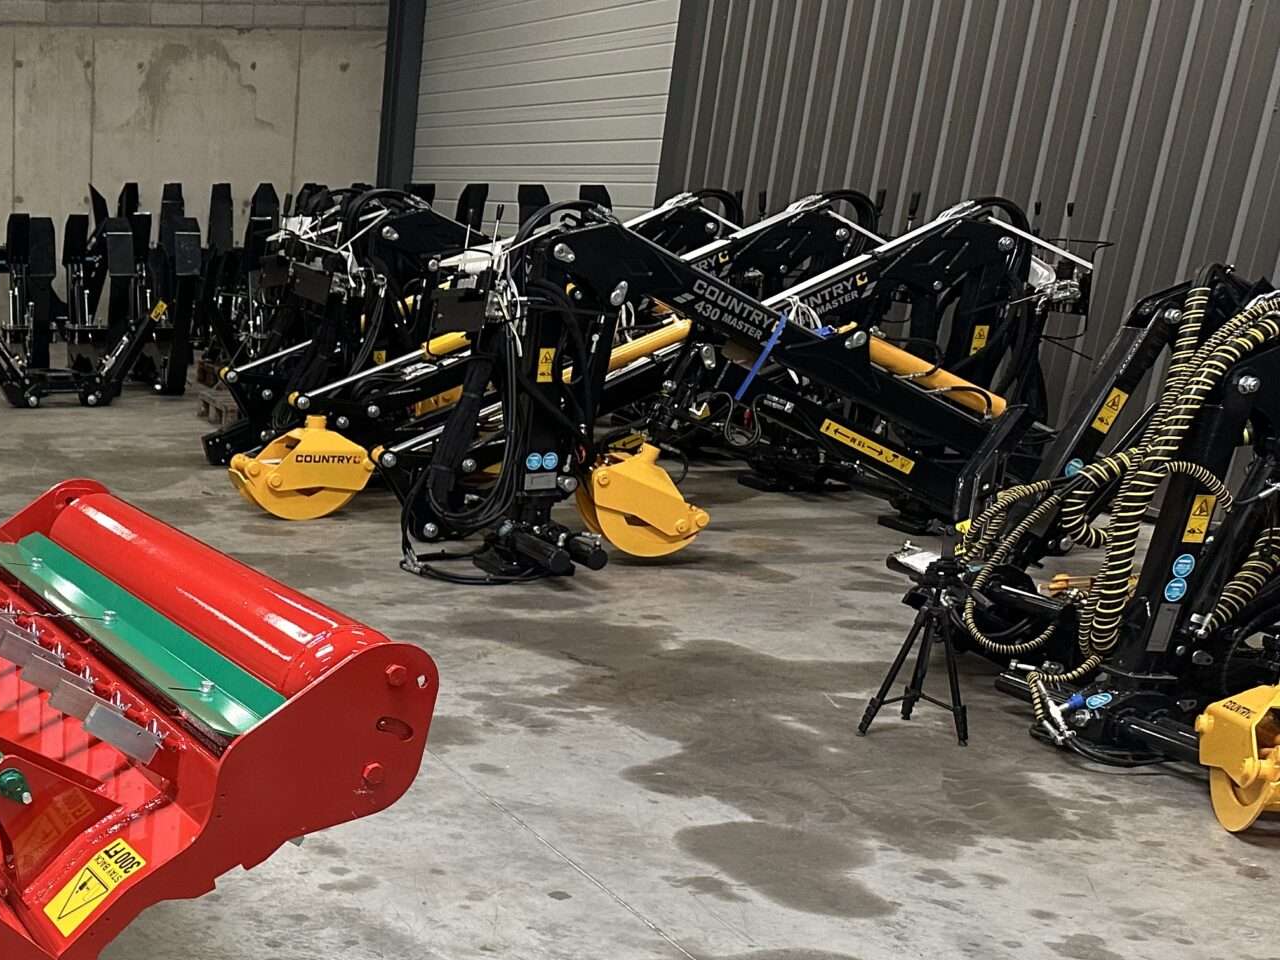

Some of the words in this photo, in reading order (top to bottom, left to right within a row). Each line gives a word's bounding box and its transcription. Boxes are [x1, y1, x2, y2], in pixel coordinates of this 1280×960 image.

[693, 279, 774, 328] COUNTRY
[816, 291, 859, 315] MASTER
[694, 301, 720, 320] 430
[721, 313, 763, 340] MASTER
[103, 842, 126, 859] FT
[95, 854, 111, 871] BACK
[114, 851, 141, 874] 300
[106, 867, 122, 883] STAY
